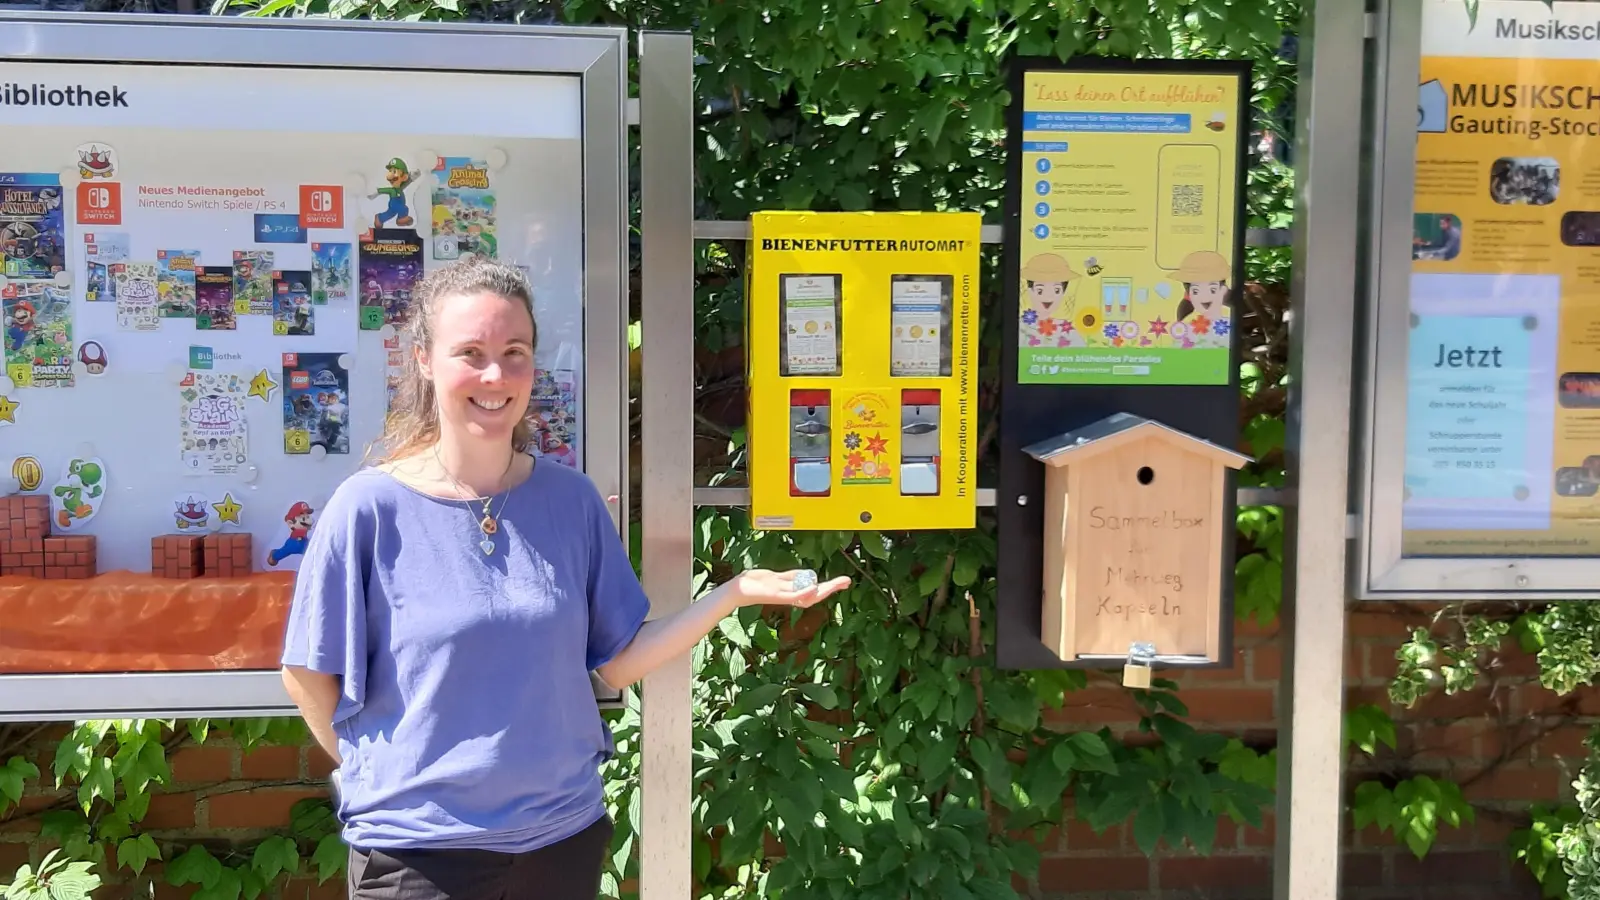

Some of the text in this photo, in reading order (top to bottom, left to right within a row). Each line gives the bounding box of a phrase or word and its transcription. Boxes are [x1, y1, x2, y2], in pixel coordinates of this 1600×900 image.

[1495, 18, 1600, 40] Musiksc
[0, 82, 129, 107] ibliothek
[1450, 115, 1600, 140] Gauting-Stoc
[138, 186, 265, 197] Neues Medienangebot
[1039, 184, 1047, 193] 2
[138, 199, 184, 209] Nintendo
[187, 199, 219, 209] Switch
[223, 200, 253, 211] Spiele
[264, 201, 277, 210] PS
[279, 201, 286, 210] 4
[1039, 206, 1046, 215] 3
[959, 274, 970, 395] www.bienenretter.com
[1434, 343, 1503, 368] Jetzt
[958, 398, 967, 415] mit
[957, 418, 968, 484] Kooperation
[1090, 506, 1204, 531] Sammelbox
